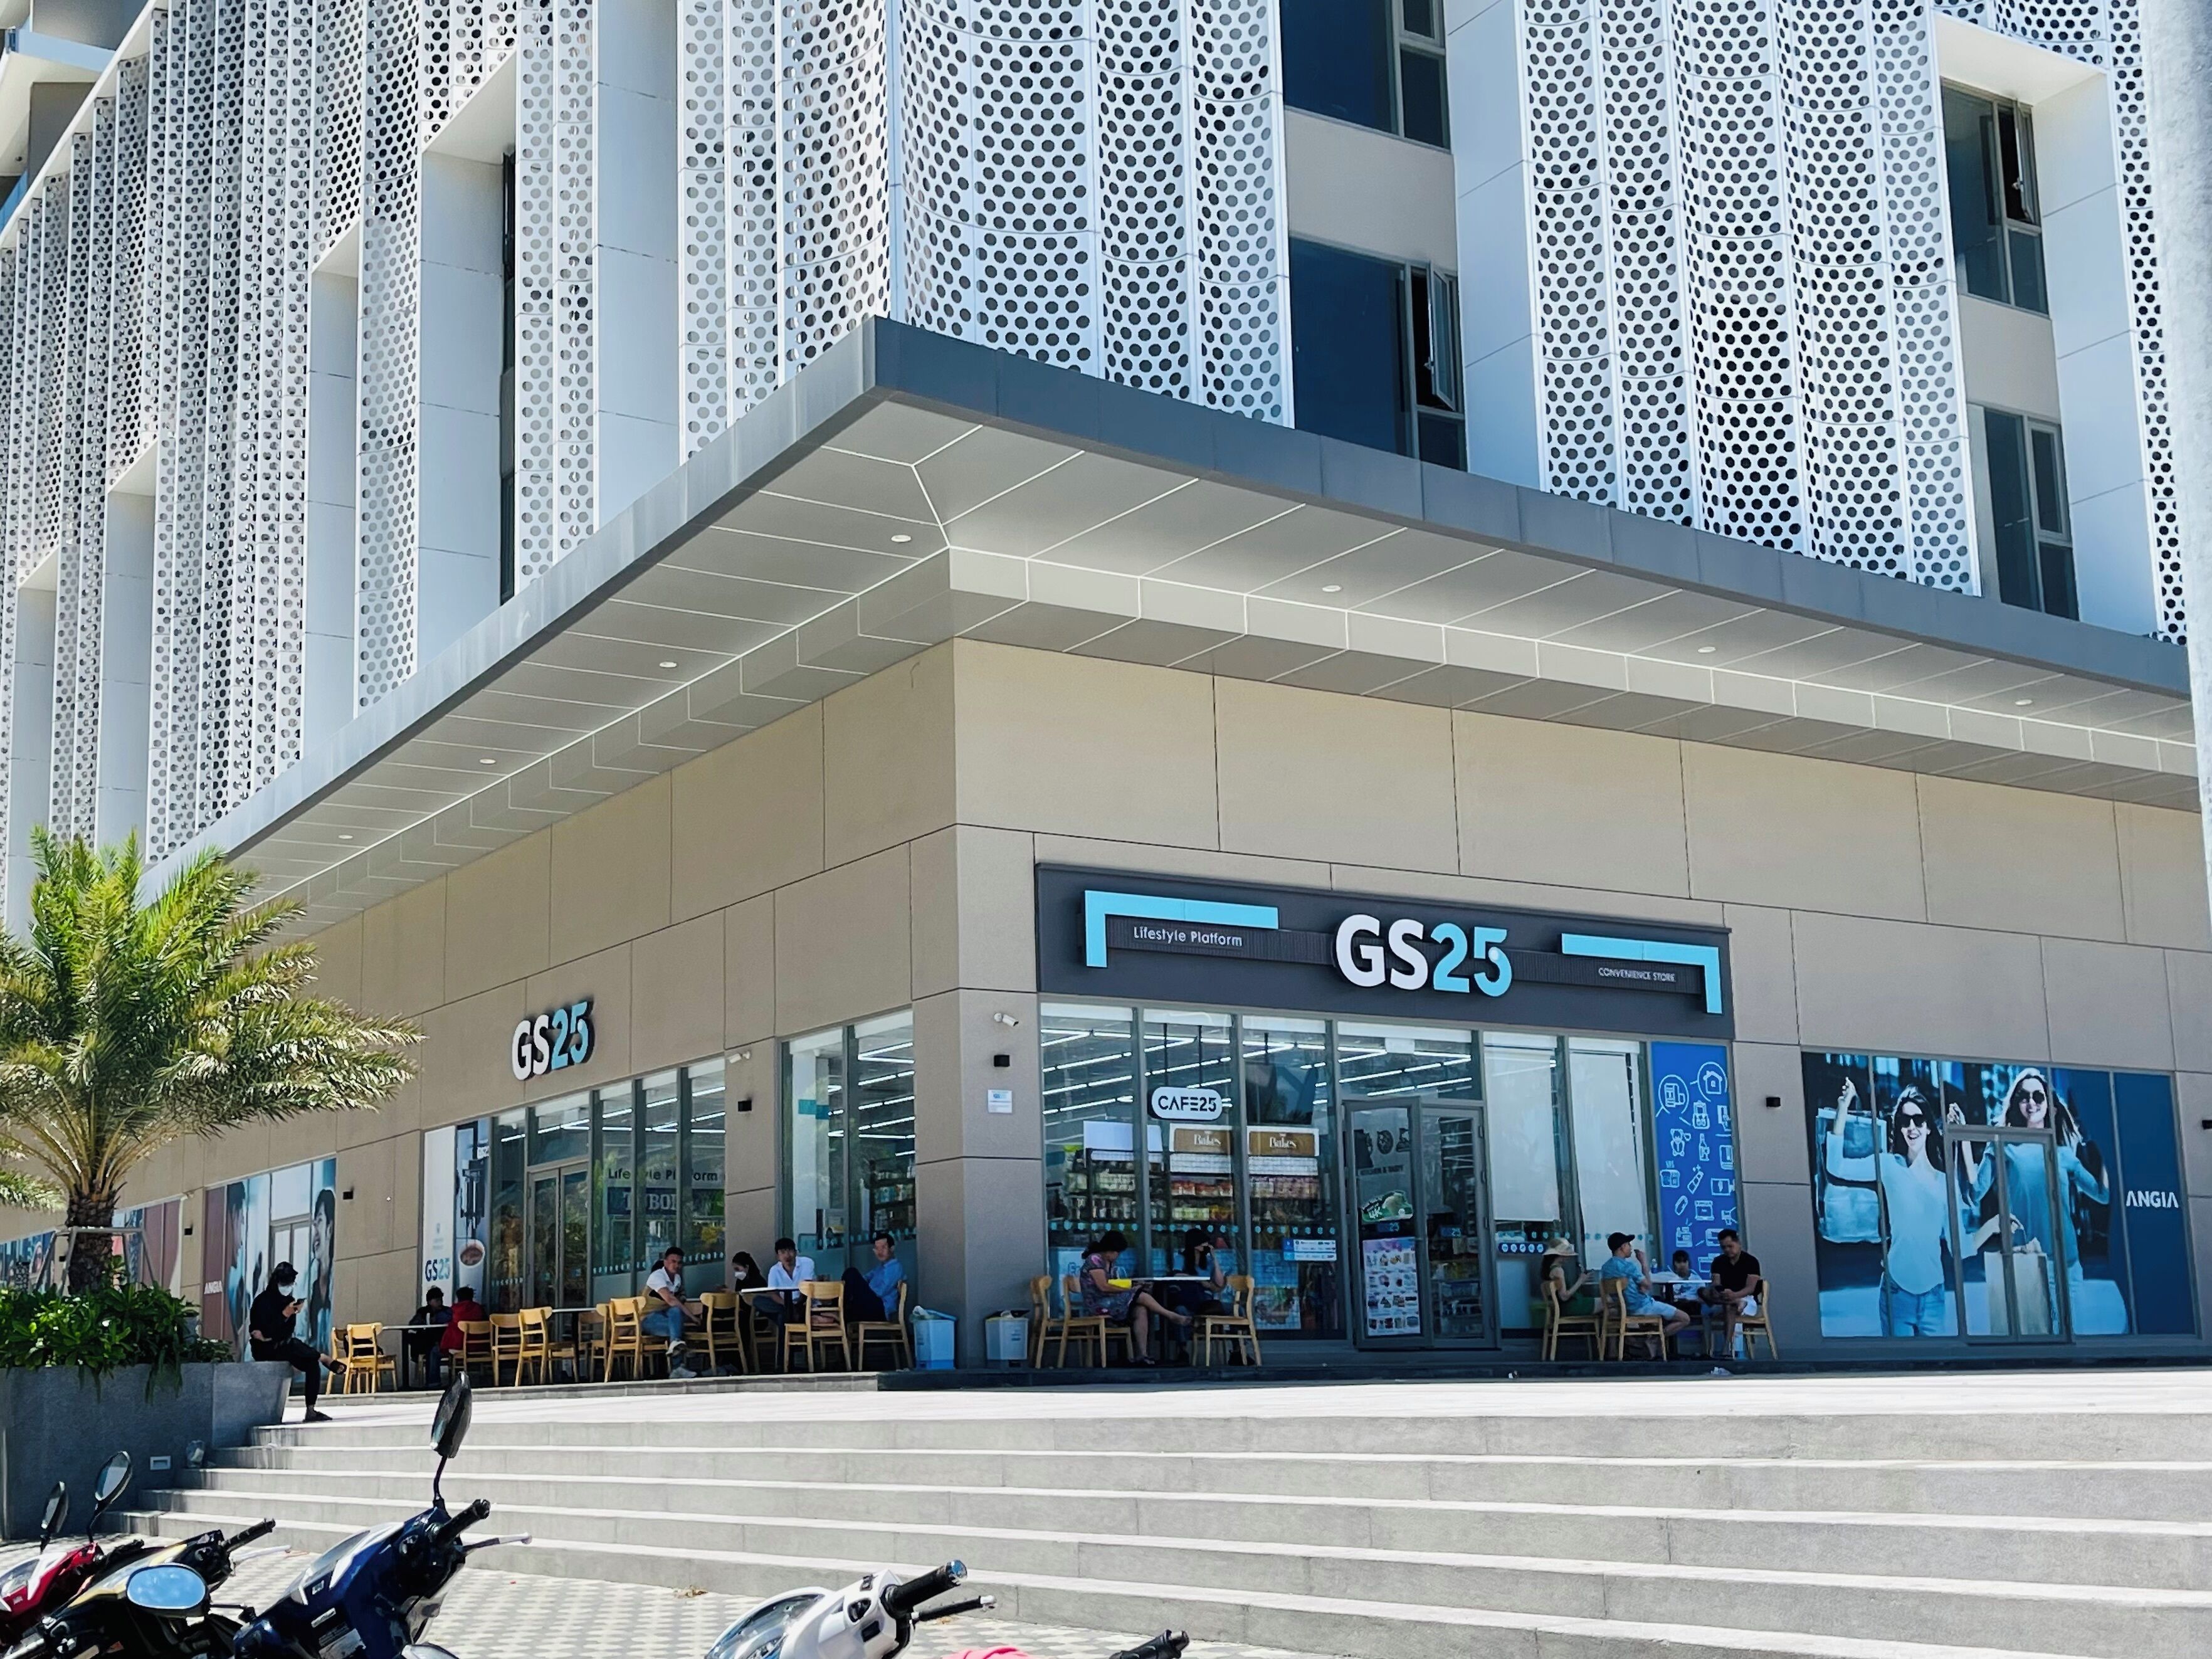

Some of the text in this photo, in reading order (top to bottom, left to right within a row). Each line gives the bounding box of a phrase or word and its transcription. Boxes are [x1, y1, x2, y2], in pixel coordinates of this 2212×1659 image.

[1134, 926, 1243, 947] Lifestyle Platform
[1336, 914, 1512, 997] GS25
[512, 1001, 589, 1080] GS25
[1158, 1095, 1217, 1112] CAFE25
[2126, 1190, 2179, 1209] ANGIA
[425, 1258, 450, 1282] GS25
